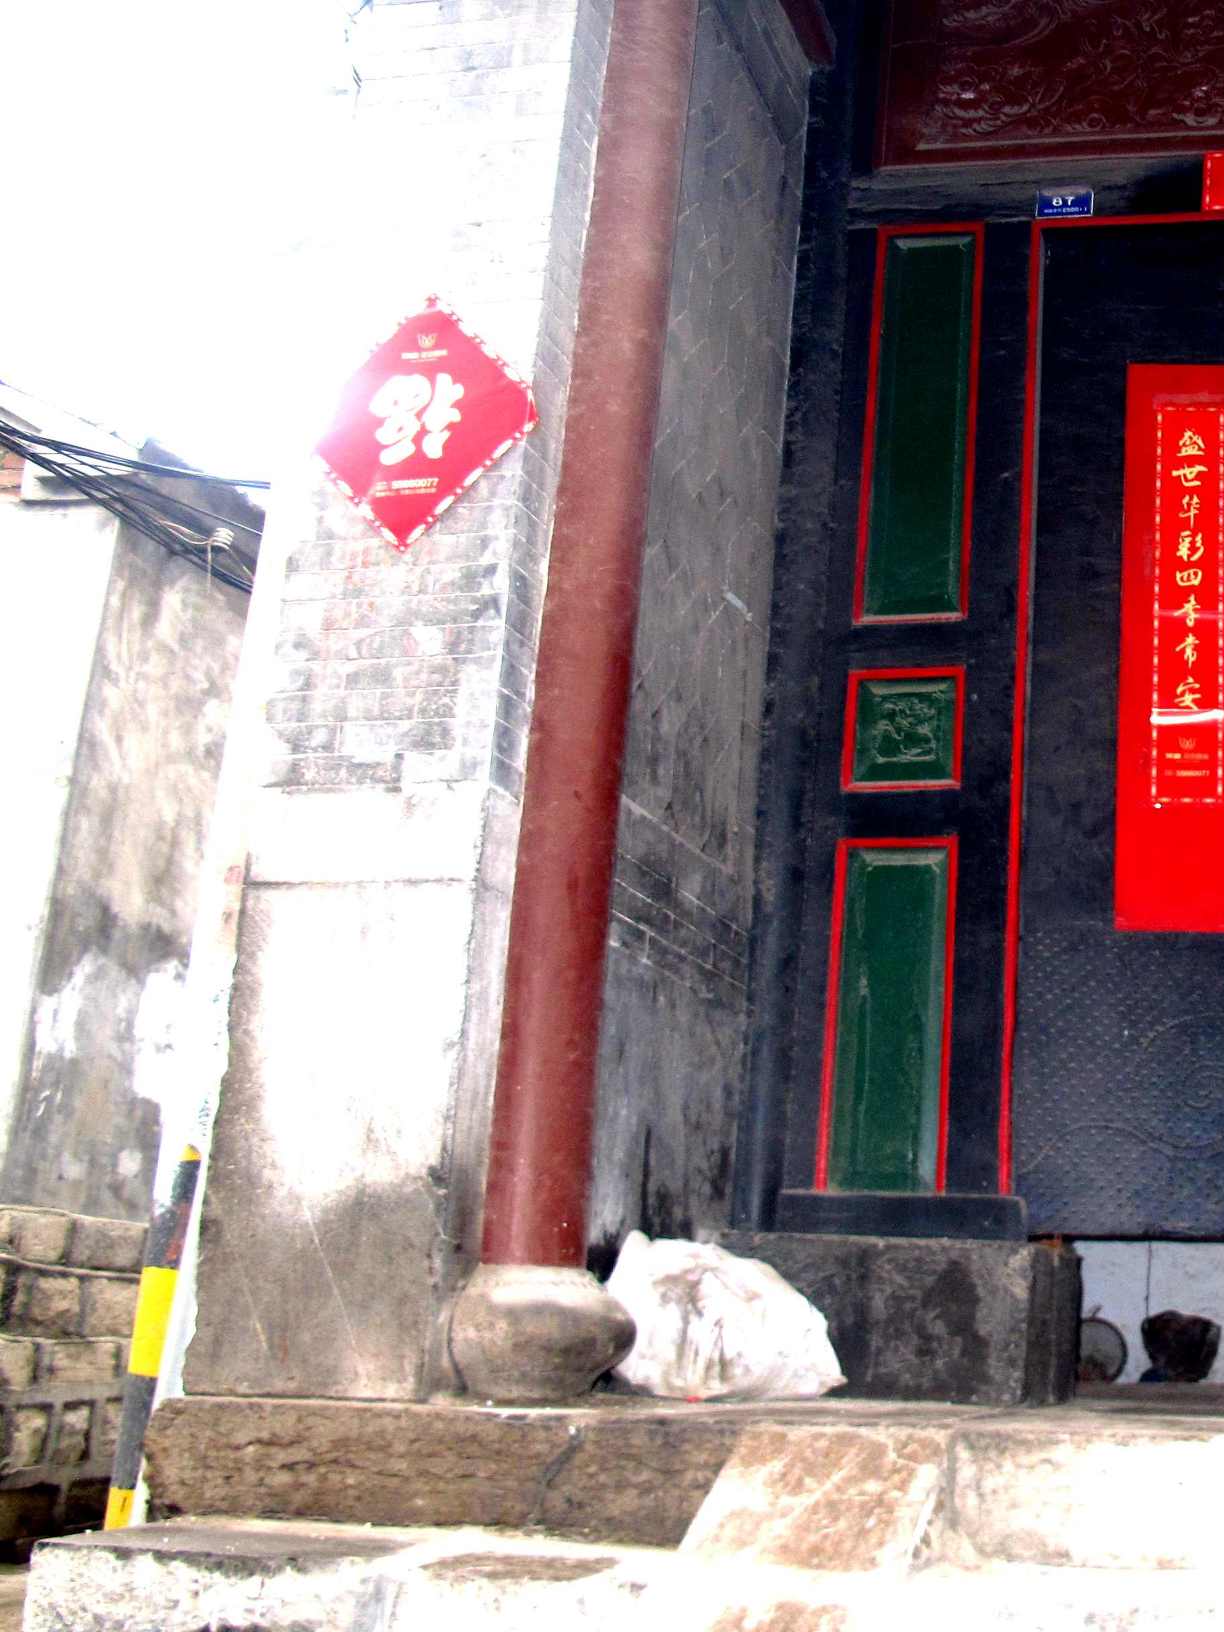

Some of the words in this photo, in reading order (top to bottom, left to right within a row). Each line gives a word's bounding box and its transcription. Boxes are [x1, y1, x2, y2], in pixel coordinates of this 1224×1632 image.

[368, 372, 464, 465] 福
[1171, 430, 1208, 710] 盛世华彩四季常安
